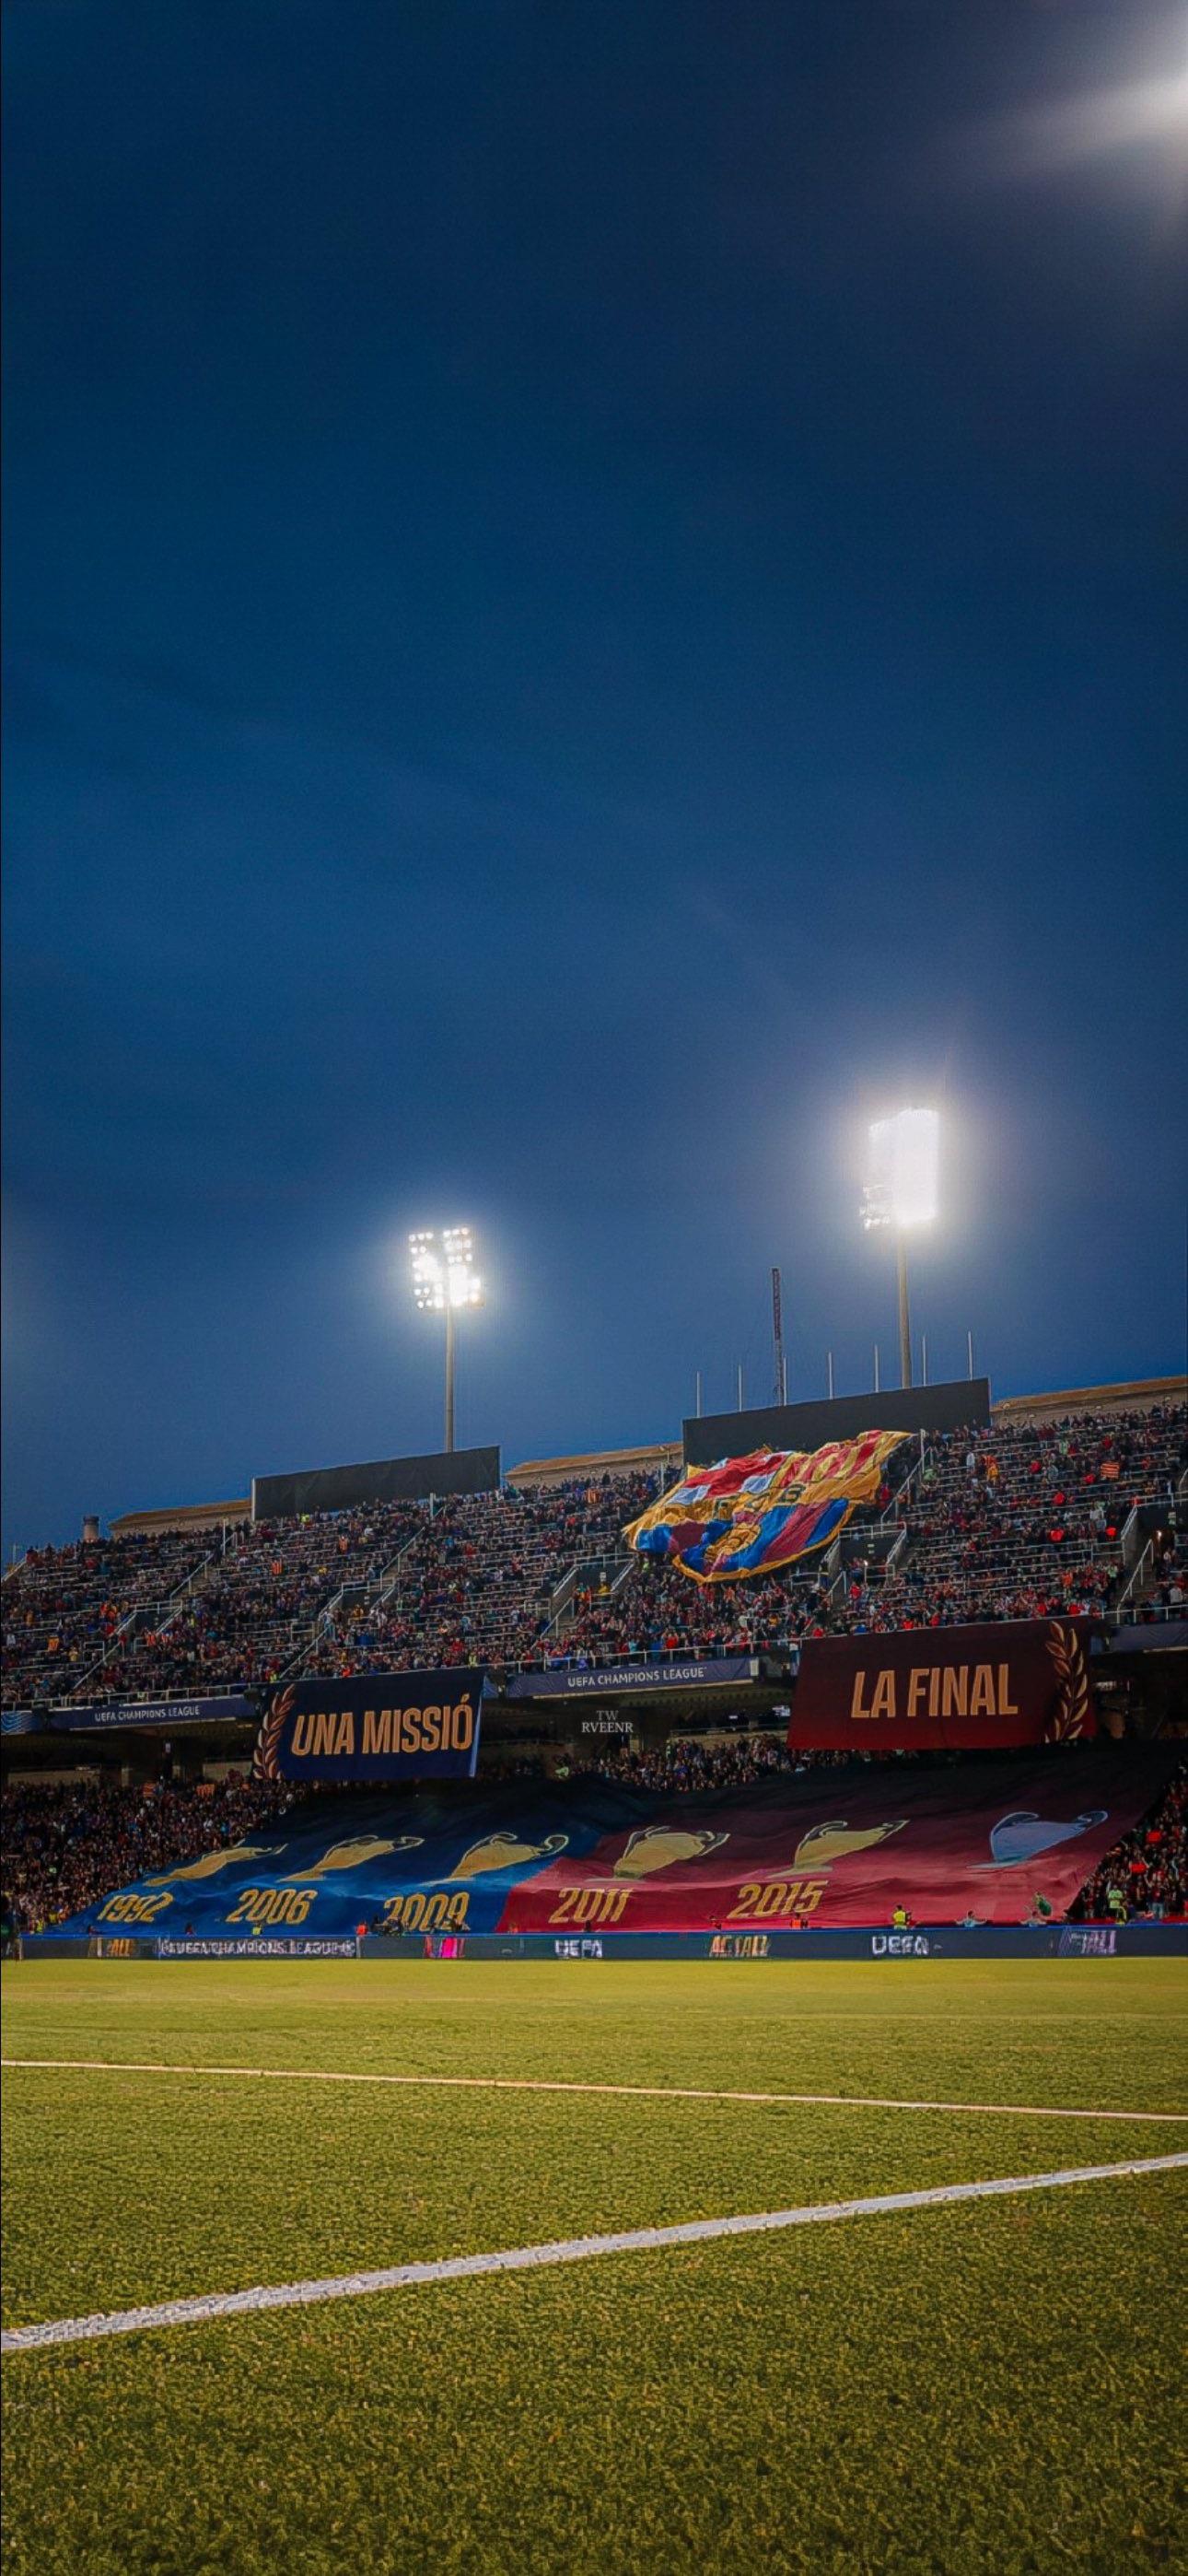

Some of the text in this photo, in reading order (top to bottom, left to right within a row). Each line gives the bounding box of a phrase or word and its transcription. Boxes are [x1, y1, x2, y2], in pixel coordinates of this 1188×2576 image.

[567, 1667, 705, 1688] UEFA CHAMPIONS LEAGUE
[851, 1663, 1019, 1718] LA FINAL
[94, 1704, 201, 1722] UEFA CHAMPIONS LEAGUE
[291, 1692, 472, 1756] UNA MISSIÓ
[97, 1879, 829, 1932] 1992 2006 2009 2011 2015
